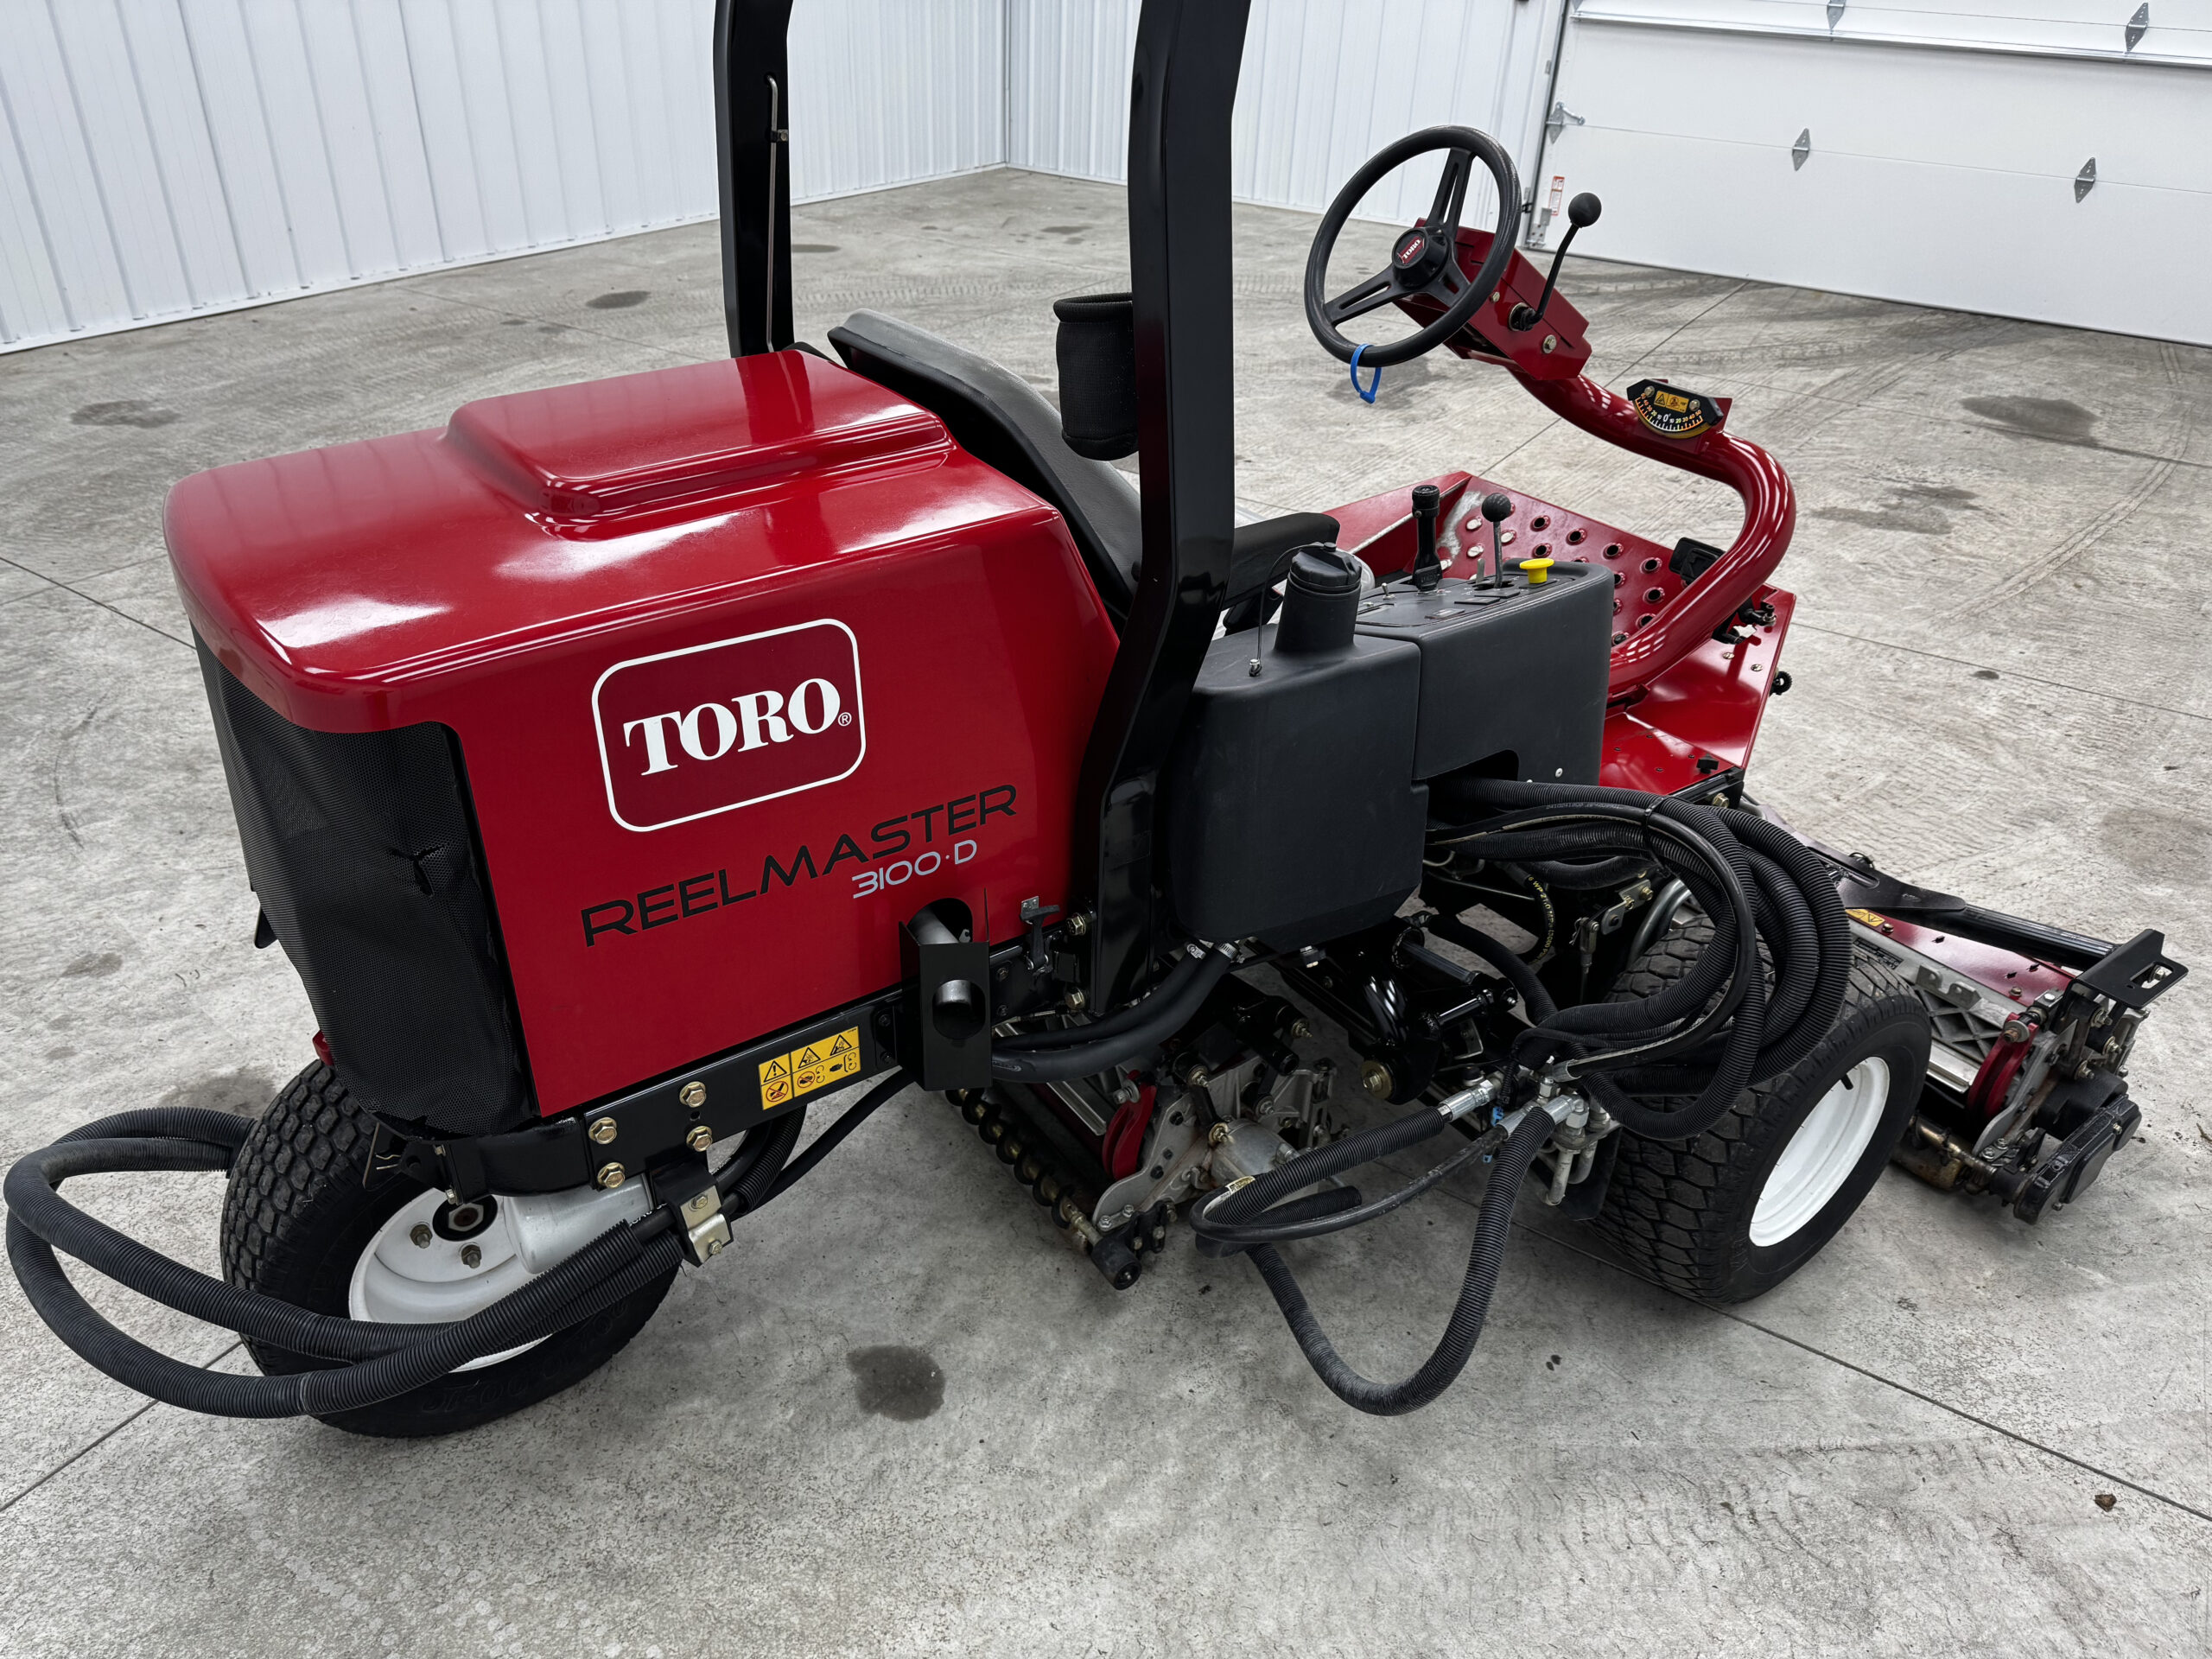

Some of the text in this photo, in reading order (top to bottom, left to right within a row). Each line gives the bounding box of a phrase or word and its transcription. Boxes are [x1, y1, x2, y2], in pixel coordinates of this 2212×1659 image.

[1402, 239, 1421, 259] TORO
[580, 784, 1018, 948] REELMASTER
[1532, 880, 1544, 893] WP
